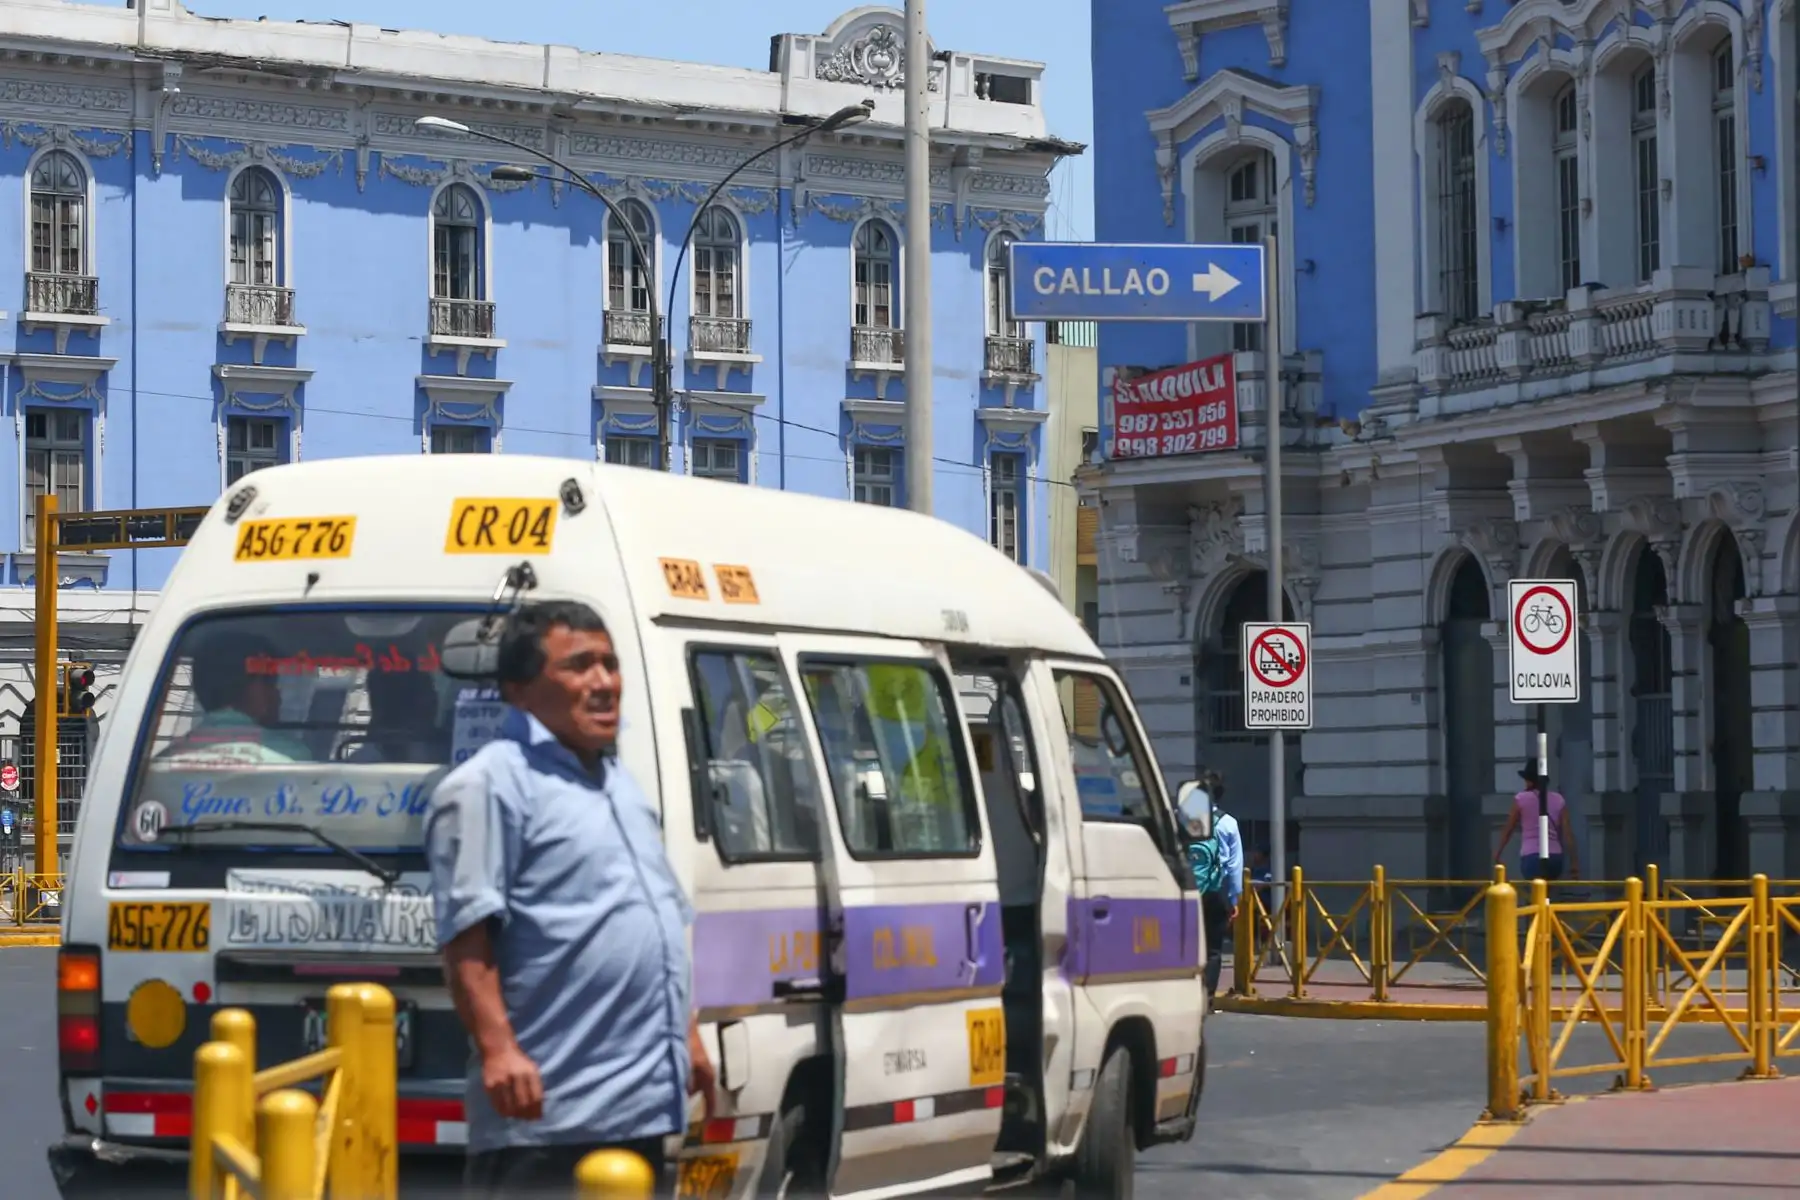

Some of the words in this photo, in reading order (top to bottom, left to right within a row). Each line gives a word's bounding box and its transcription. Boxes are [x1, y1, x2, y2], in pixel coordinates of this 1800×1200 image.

[1033, 267, 1170, 296] CALLAO
[1138, 363, 1226, 402] ALQUILA
[1119, 413, 1158, 433] 987
[1161, 408, 1194, 430] 337
[1198, 400, 1226, 424] 856
[1118, 437, 1158, 456] 998
[1161, 432, 1197, 454] 302
[1199, 425, 1227, 448] 799
[1516, 673, 1572, 688] CICLOVIA
[1251, 691, 1305, 703] PARADERO
[1251, 709, 1305, 721] PROHIBIDO
